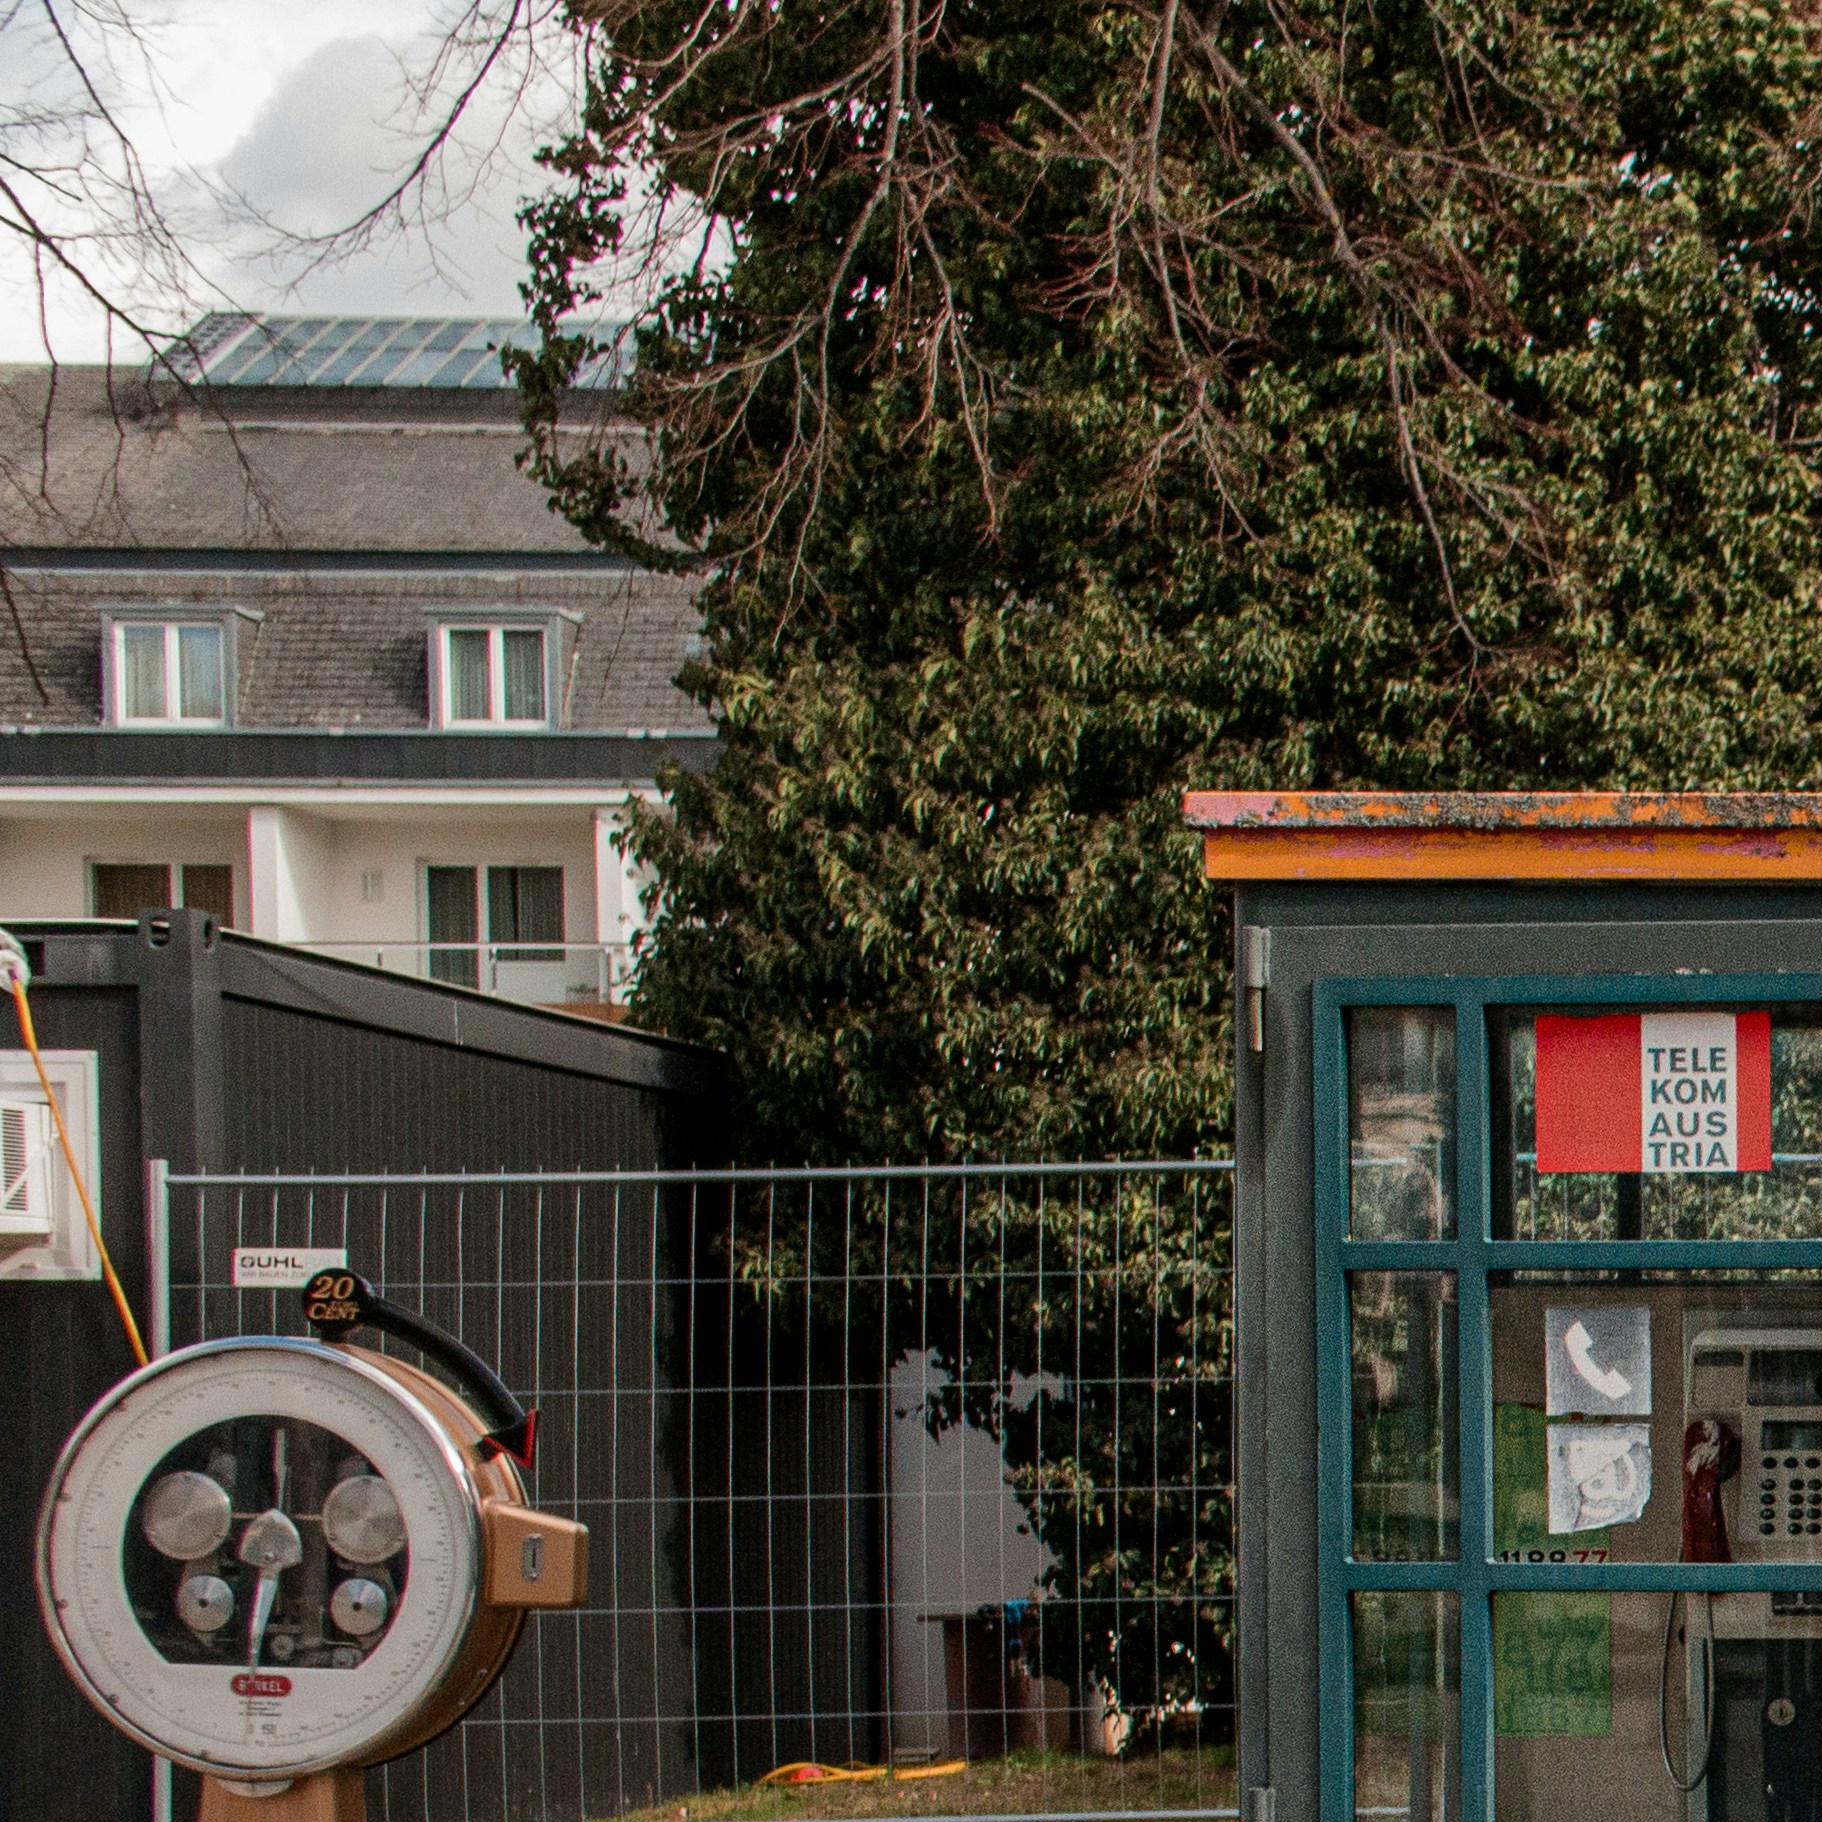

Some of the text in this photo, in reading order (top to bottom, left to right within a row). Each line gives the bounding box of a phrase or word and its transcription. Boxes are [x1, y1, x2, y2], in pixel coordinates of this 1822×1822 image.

[1647, 1047, 1727, 1073] TELE
[1651, 1078, 1727, 1104] KOM
[1648, 1110, 1728, 1137] AUS
[1648, 1142, 1729, 1167] TRIA
[310, 1275, 354, 1300] 20
